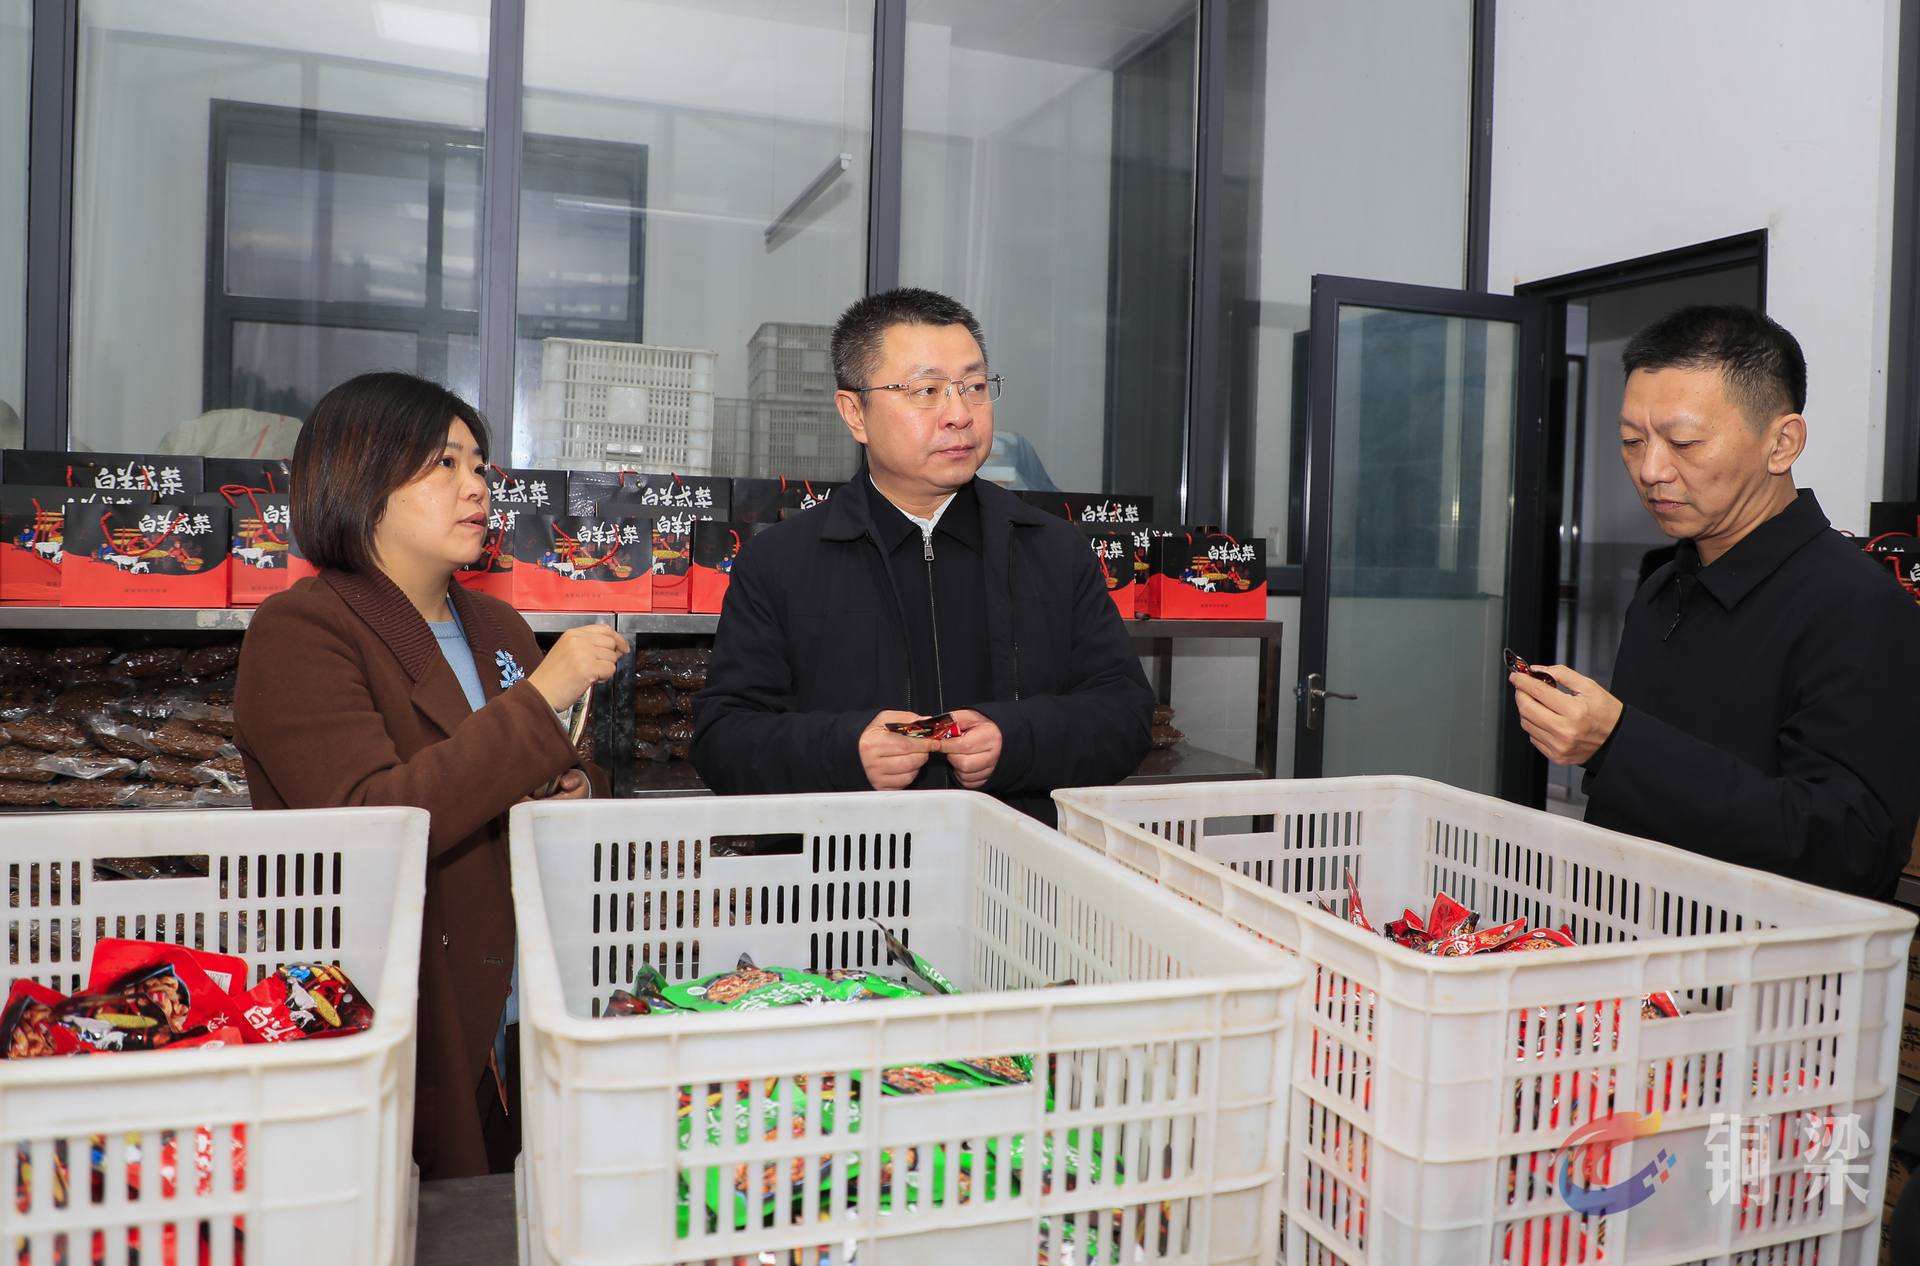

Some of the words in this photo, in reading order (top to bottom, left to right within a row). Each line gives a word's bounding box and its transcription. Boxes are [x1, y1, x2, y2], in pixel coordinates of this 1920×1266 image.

[94, 460, 185, 498] 白羊咸菜
[487, 478, 551, 507] 羊咸菜
[641, 481, 713, 508] 白羊咸菜
[138, 510, 213, 537] 白羊咸菜
[1081, 500, 1139, 523] 白羊咸菜
[576, 521, 640, 549] 白羊咸菜
[1207, 541, 1257, 567] 白羊咸菜
